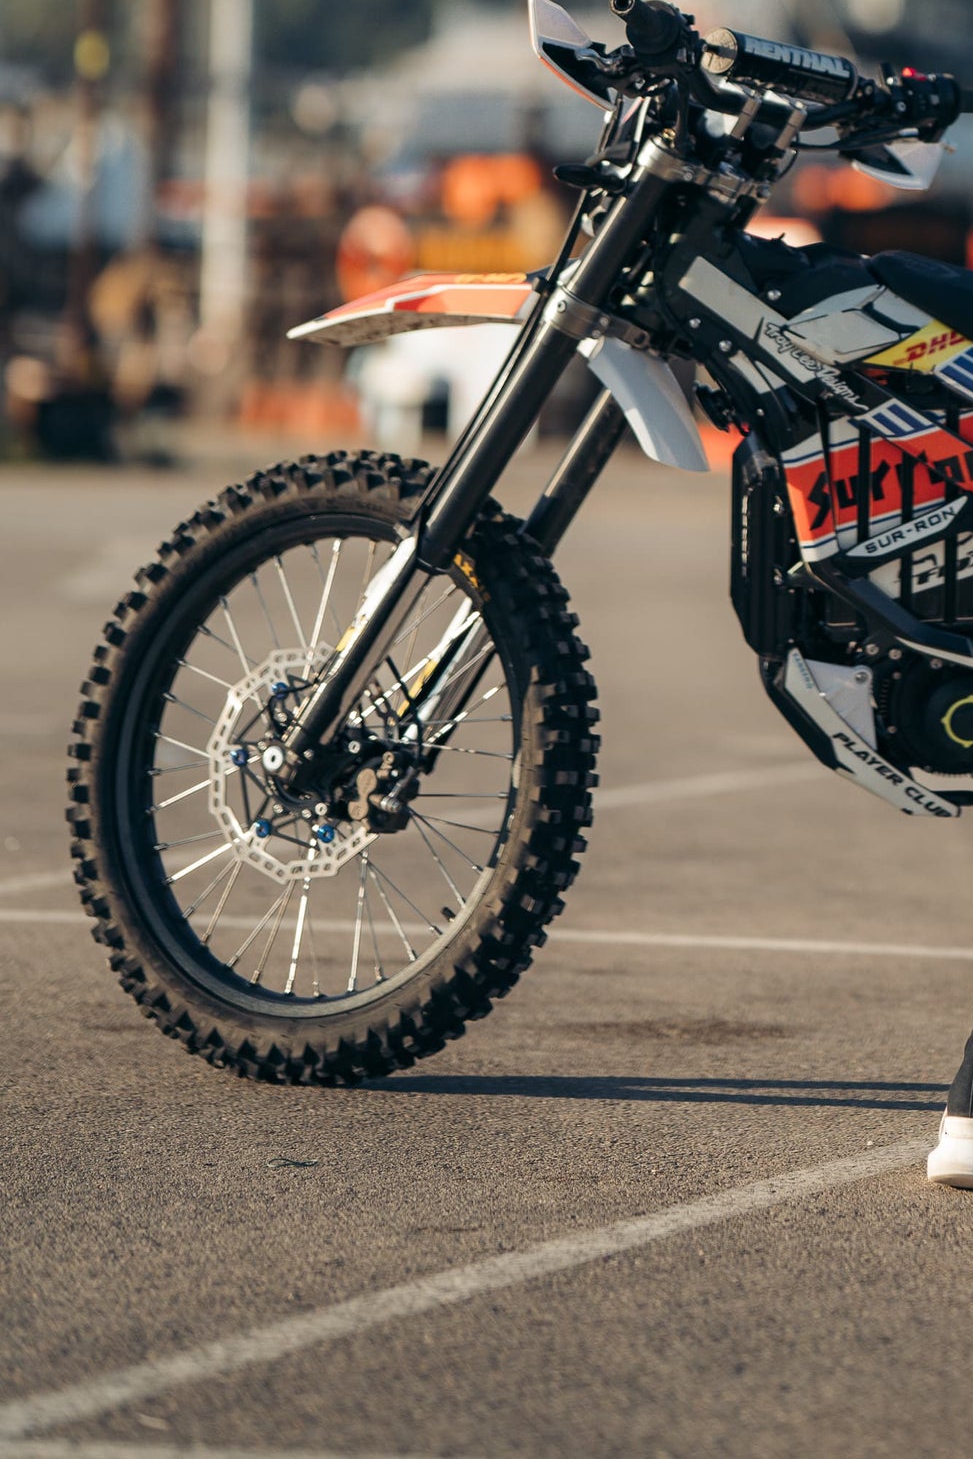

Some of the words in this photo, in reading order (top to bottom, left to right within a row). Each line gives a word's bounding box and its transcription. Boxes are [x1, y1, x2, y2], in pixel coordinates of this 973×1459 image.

[744, 35, 851, 78] RENTHAL
[905, 330, 967, 362] DHL
[816, 367, 869, 410] Designs
[865, 506, 957, 554] SUR-RON
[832, 731, 904, 787] PLAYER
